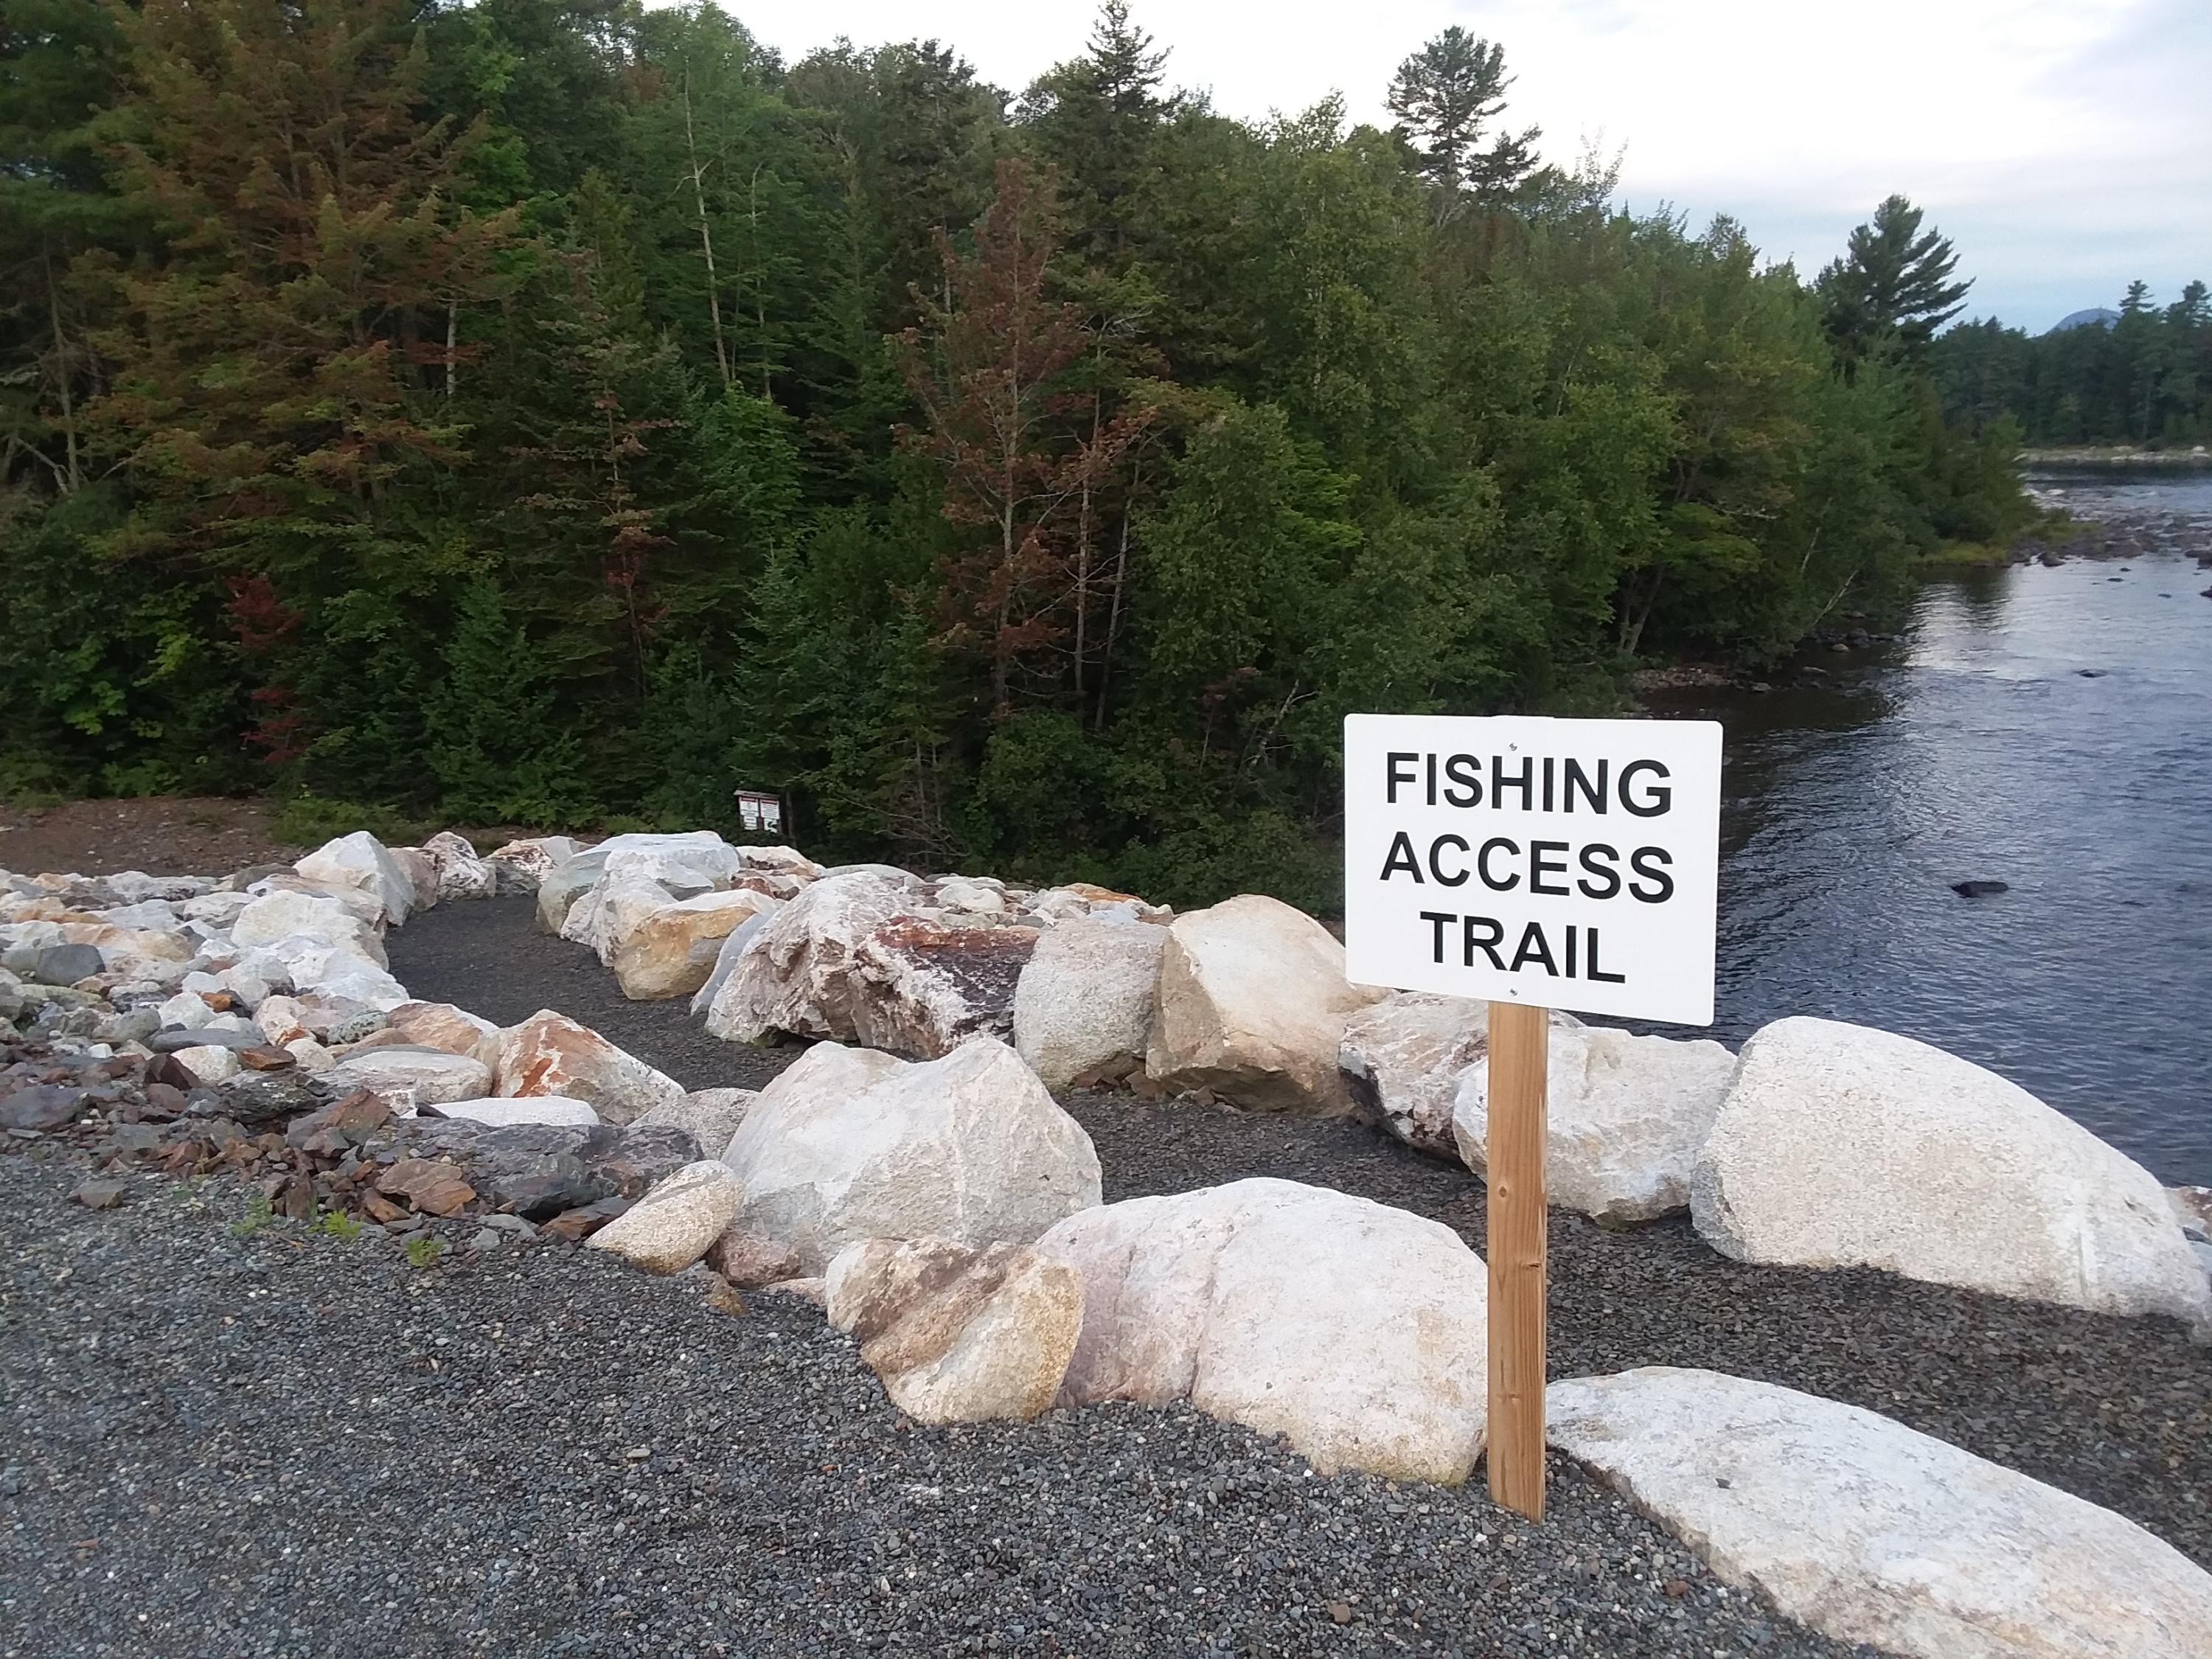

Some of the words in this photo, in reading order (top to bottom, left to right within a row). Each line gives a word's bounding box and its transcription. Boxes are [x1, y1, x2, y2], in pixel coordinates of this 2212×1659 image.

[1387, 752, 1672, 818] FISHING
[1380, 831, 1674, 904] ACCESS
[1419, 911, 1626, 984] TRAIL
